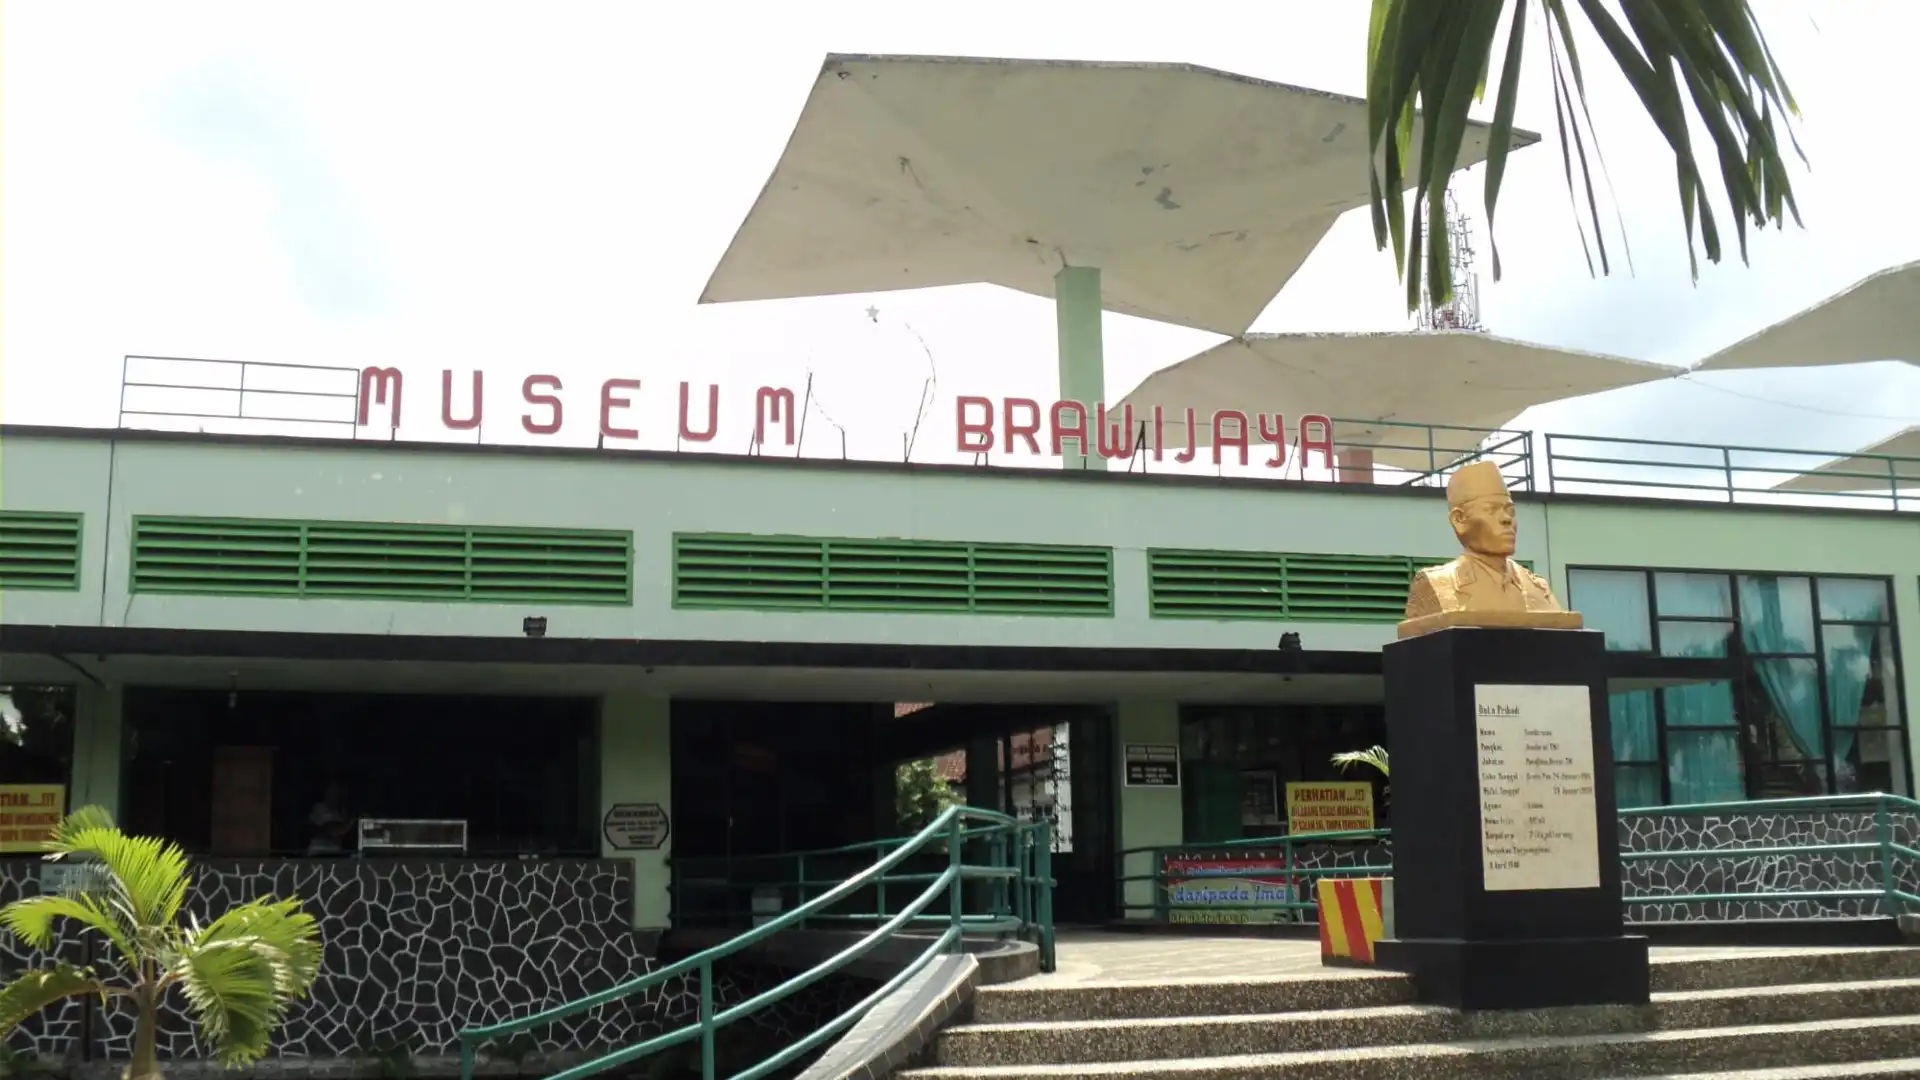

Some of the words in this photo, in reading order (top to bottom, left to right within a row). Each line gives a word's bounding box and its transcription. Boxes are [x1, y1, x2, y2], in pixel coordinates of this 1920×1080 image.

[358, 366, 796, 448] MUSEUM
[955, 395, 1335, 471] BRAWIJAYA
[1175, 885, 1249, 905] daripada
[1255, 885, 1287, 900] Ima
